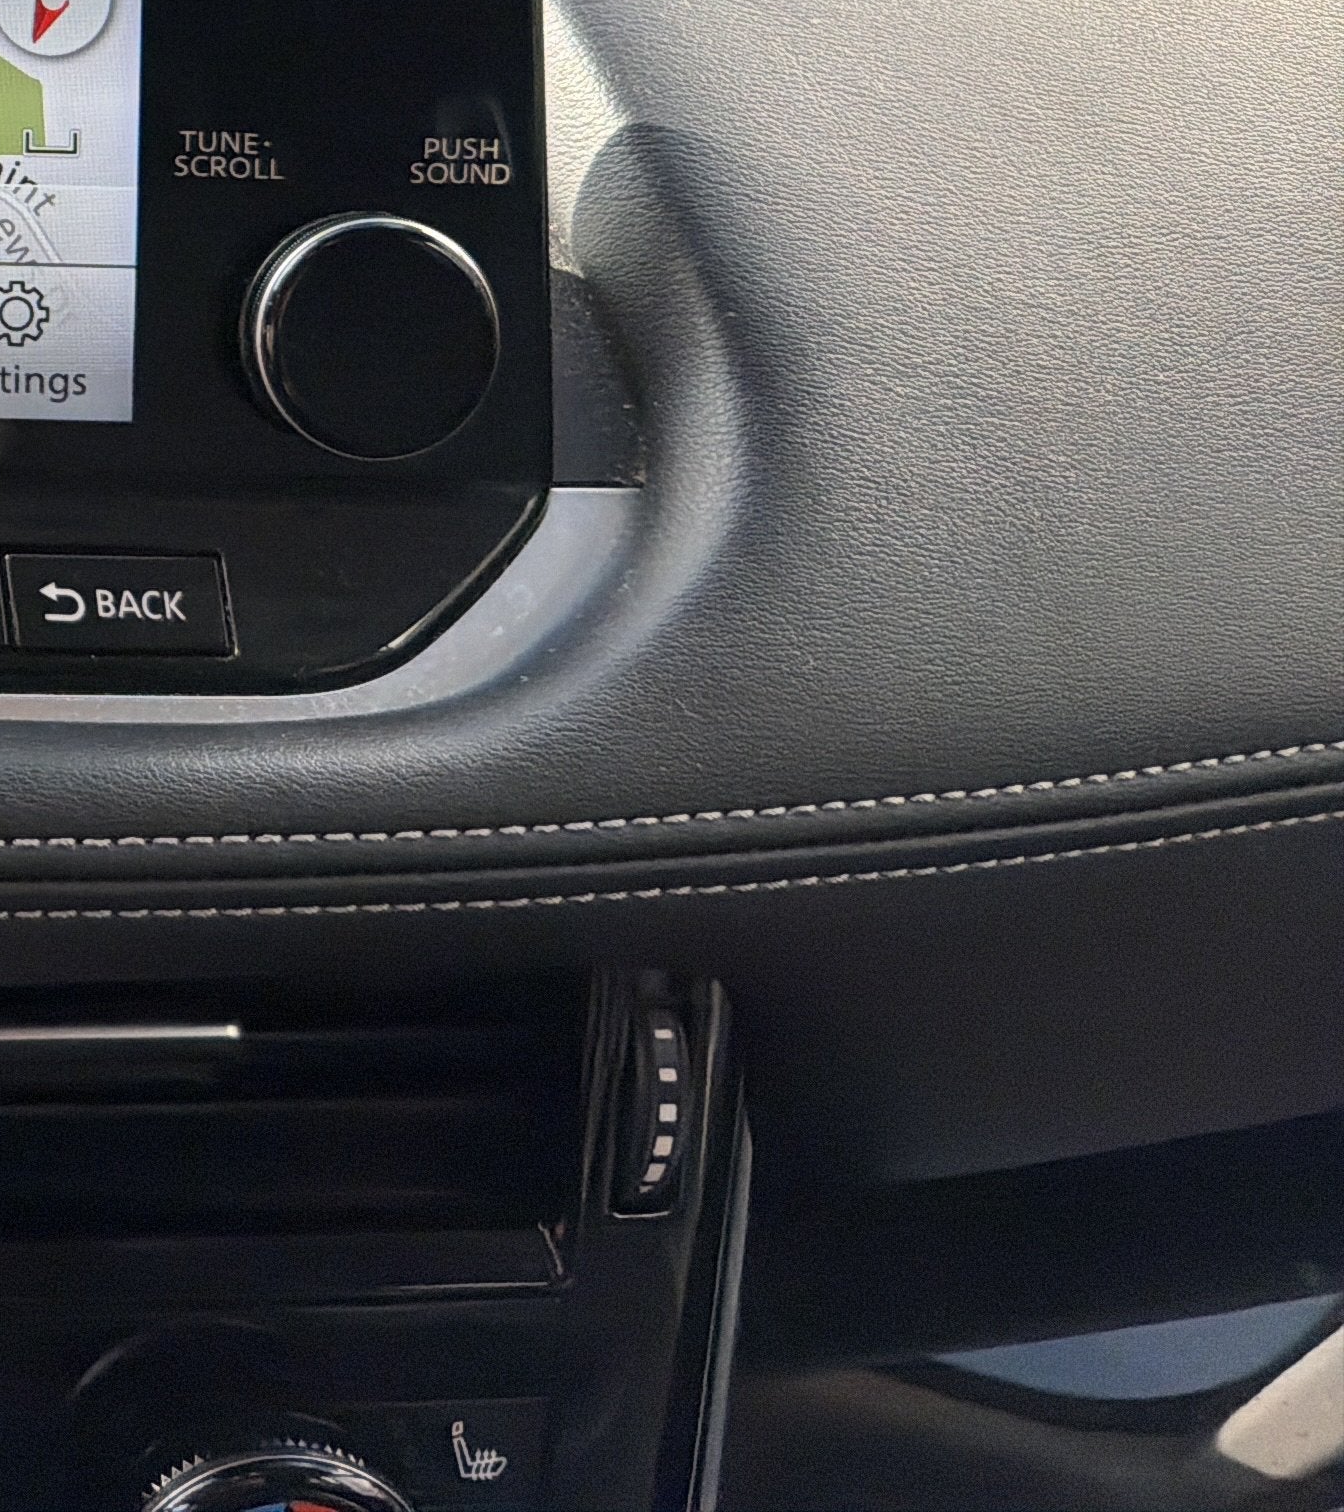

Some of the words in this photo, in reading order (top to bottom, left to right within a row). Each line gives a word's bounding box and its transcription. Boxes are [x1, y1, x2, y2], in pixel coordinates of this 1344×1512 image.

[423, 137, 499, 161] PUSH
[174, 155, 286, 180] SCROLL
[410, 162, 511, 185] SOUND
[96, 589, 187, 622] BACK
